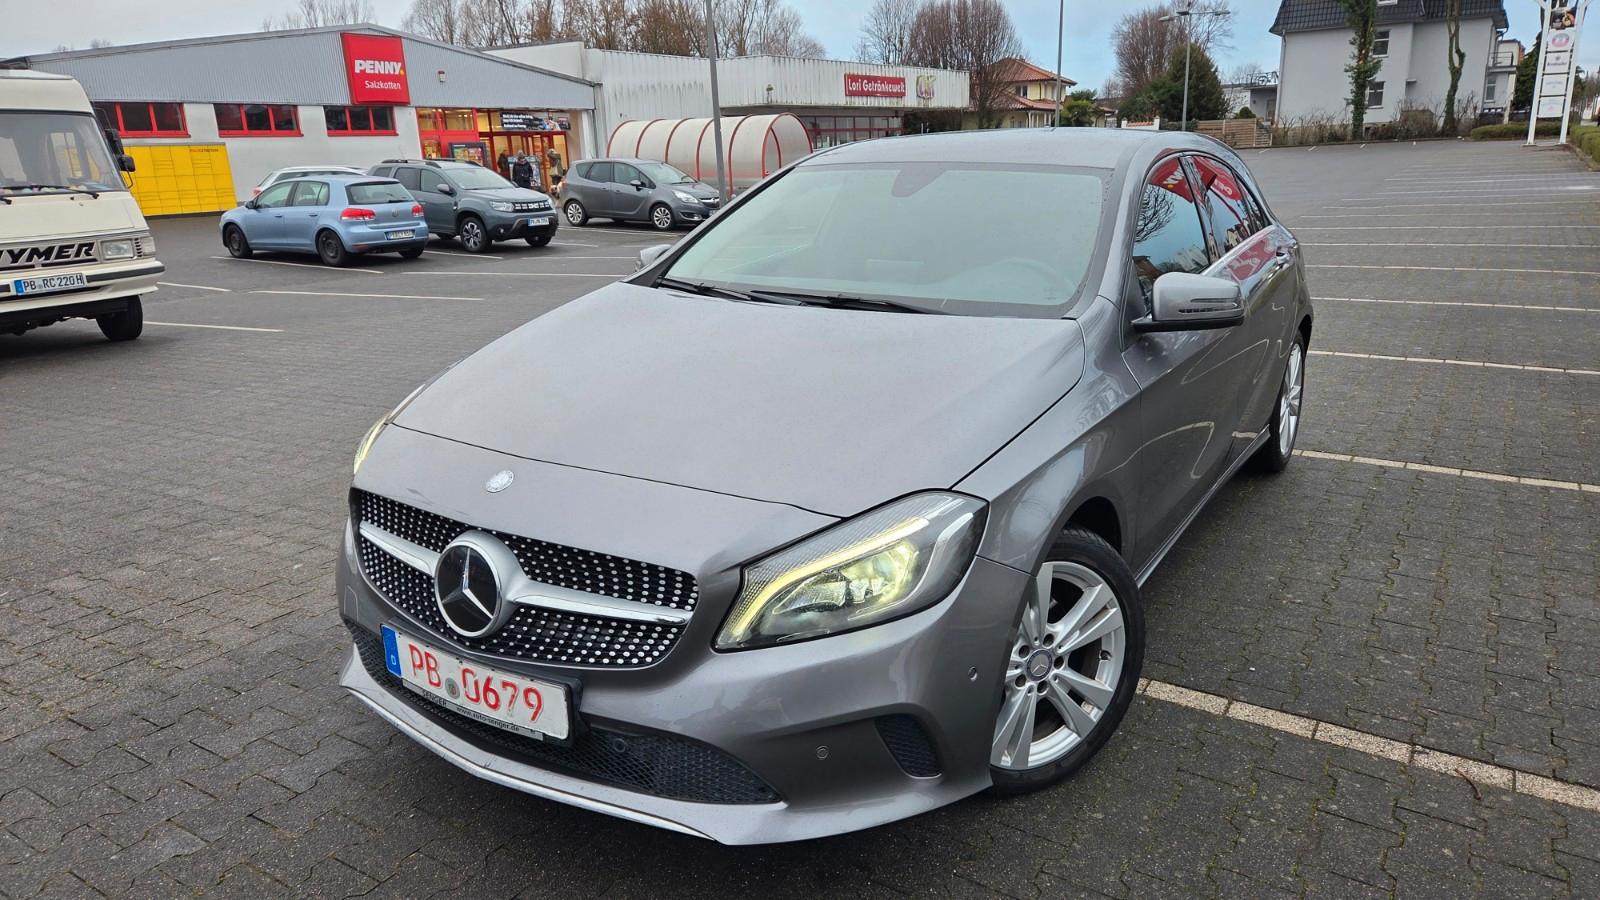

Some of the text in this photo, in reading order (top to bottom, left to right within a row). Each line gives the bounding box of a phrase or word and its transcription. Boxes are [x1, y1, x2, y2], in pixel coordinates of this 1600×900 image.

[364, 80, 402, 90] Salzkotten
[848, 78, 862, 91] Lori
[862, 79, 905, 93] Getränkewelt
[0, 242, 95, 265] YMER
[23, 280, 37, 291] PB
[42, 278, 56, 289] RC
[391, 654, 397, 665] D
[408, 643, 544, 721] PB 0679
[456, 706, 520, 732] www.auto-senger.de
